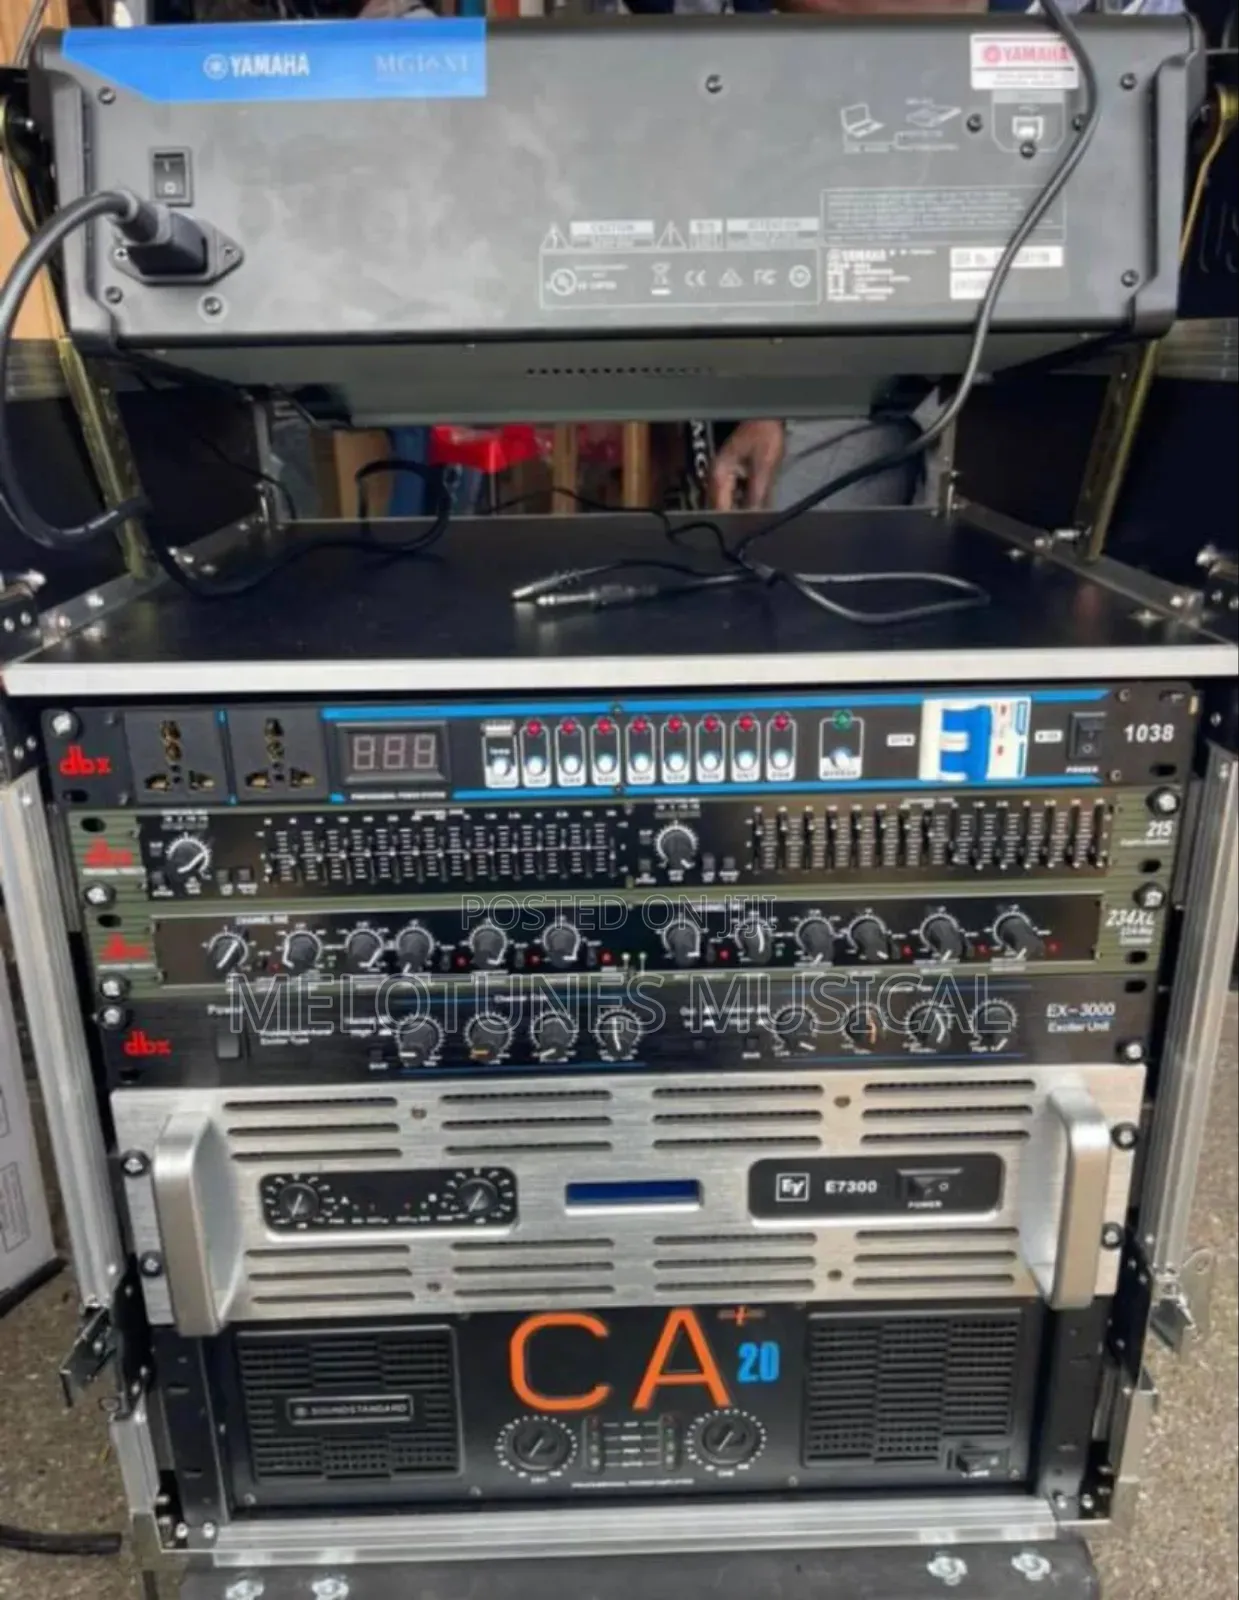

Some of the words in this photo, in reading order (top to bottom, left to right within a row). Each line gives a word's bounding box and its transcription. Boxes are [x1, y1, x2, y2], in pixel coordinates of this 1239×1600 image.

[229, 54, 310, 77] YAMAHA
[1124, 723, 1175, 743] 1038
[59, 746, 111, 776] dbx
[123, 1030, 172, 1056] dbx
[825, 1180, 877, 1193] E7300
[737, 1341, 780, 1383] 20
